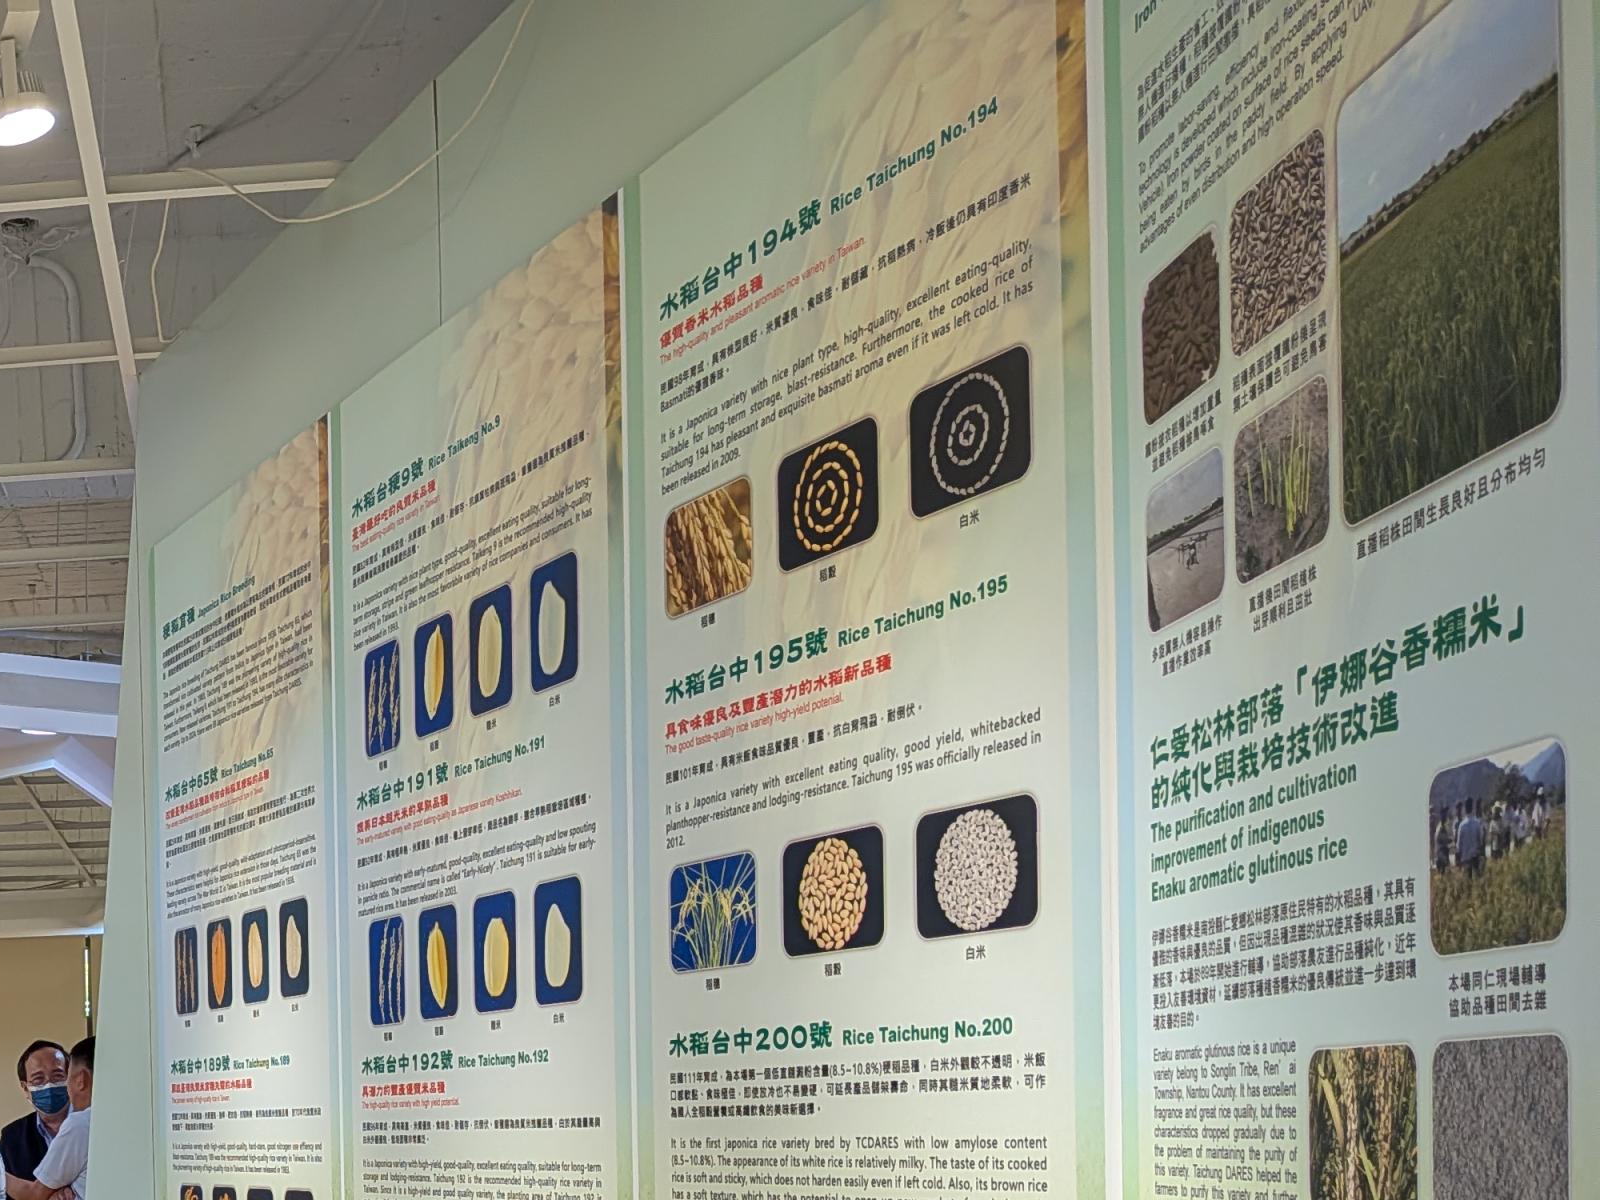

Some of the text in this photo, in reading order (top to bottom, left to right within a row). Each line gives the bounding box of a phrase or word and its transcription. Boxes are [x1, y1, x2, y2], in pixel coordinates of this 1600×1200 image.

[659, 95, 998, 321] 水稻台中194號 Rice Taichung No.194
[684, 405, 718, 431] Japonica
[720, 389, 748, 412] variety
[749, 376, 769, 396] with
[770, 367, 789, 385] nice
[791, 351, 815, 377] plant
[816, 340, 840, 362] type,
[842, 306, 902, 346] high-quality,
[905, 278, 951, 312] excellent
[953, 237, 1032, 286] eating-quality,
[427, 452, 446, 471] Rice
[446, 430, 479, 458] Taikeng
[480, 413, 501, 437] No.9
[958, 508, 980, 529] 白米
[664, 573, 1008, 705] 水稻台中195號 Rice Taichung No.195
[1149, 593, 1524, 771] 仁愛松林部落「伊娜谷香糯米」
[219, 767, 233, 779] Rice
[232, 756, 257, 779] Taichung
[257, 746, 274, 763] No.65
[355, 734, 545, 811] 水稻台中191號 Rice Taichung No.191
[665, 706, 1041, 816] It is a Japonica variety with excellent eating quality, good yield, whitebacked
[1150, 690, 1399, 810] 的純化與栽培技術改進
[1149, 763, 1357, 843] The purification and cultivation
[1150, 808, 1325, 875] improvement of indigenous
[1150, 836, 1348, 902] Enaku aromatic glutinous rice
[965, 944, 986, 961] 白米
[232, 1059, 245, 1070] Rice
[244, 1057, 270, 1070] Taichung
[269, 1054, 291, 1066] No.189
[360, 1048, 549, 1076] 水稻台中192號 Rice Taichung No.192
[668, 1016, 1013, 1058] 水稻台中200號 Rice Taichung No.200
[670, 1134, 1048, 1153] It is the first japonica rice variety bred by TCDARES with low amylose content
[670, 1186, 685, 1200] has
[685, 1190, 691, 1200] a
[692, 1187, 708, 1200] soft
